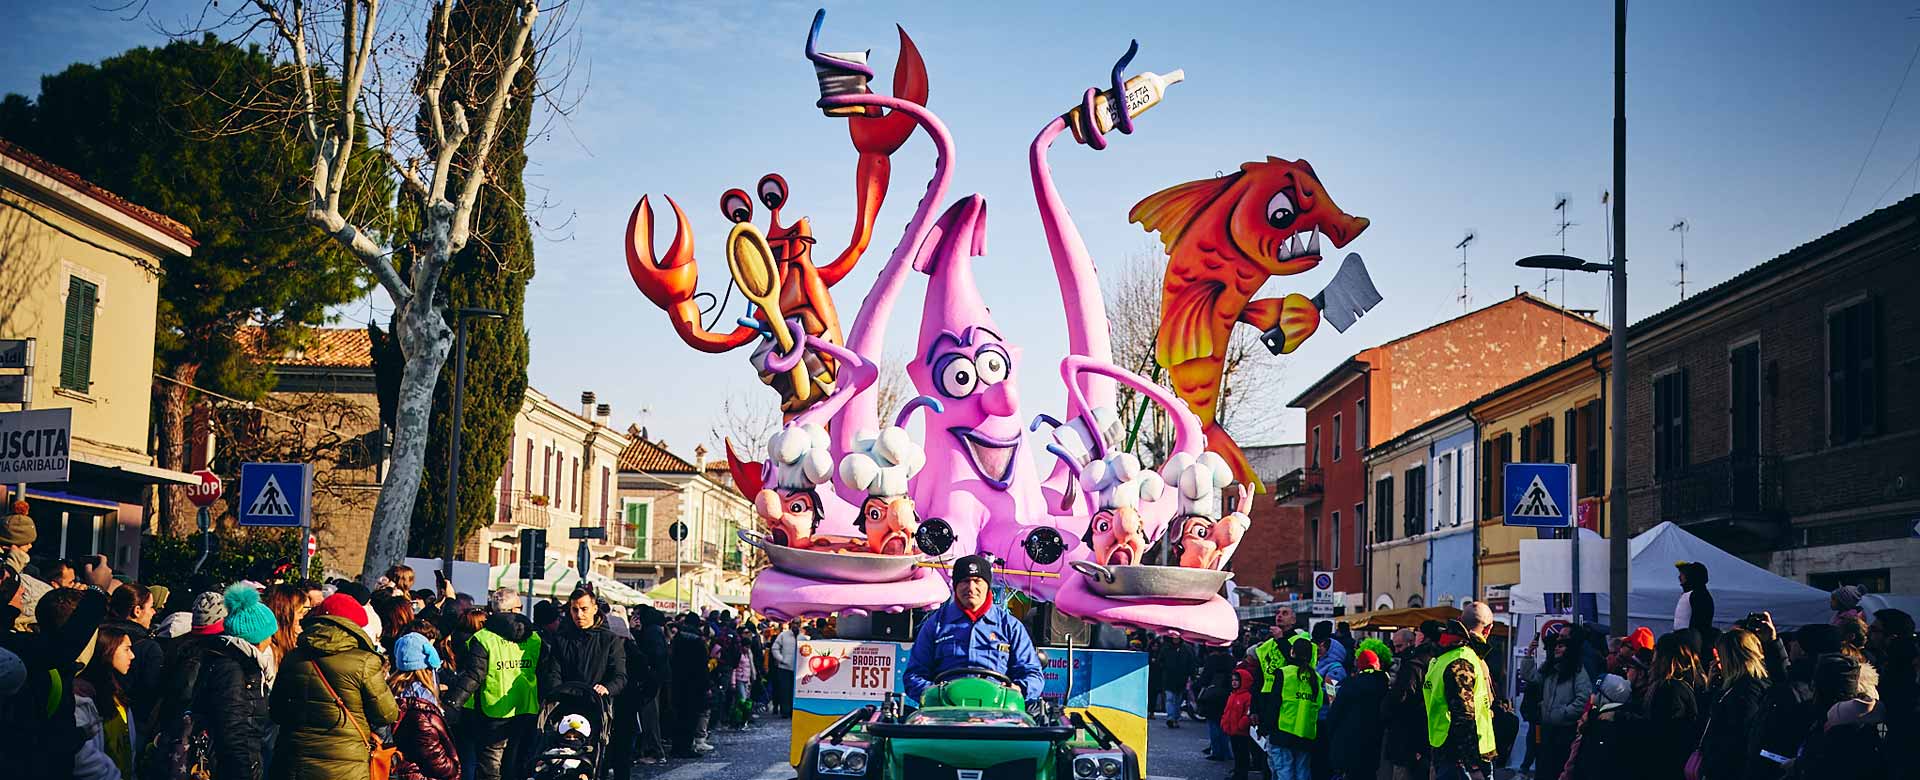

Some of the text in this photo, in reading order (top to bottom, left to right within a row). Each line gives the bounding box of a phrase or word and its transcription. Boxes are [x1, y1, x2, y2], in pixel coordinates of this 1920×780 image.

[12, 456, 69, 472] GARIBALDI
[188, 482, 219, 496] STOP
[852, 655, 891, 666] BRODETTO
[851, 666, 891, 689] FEST
